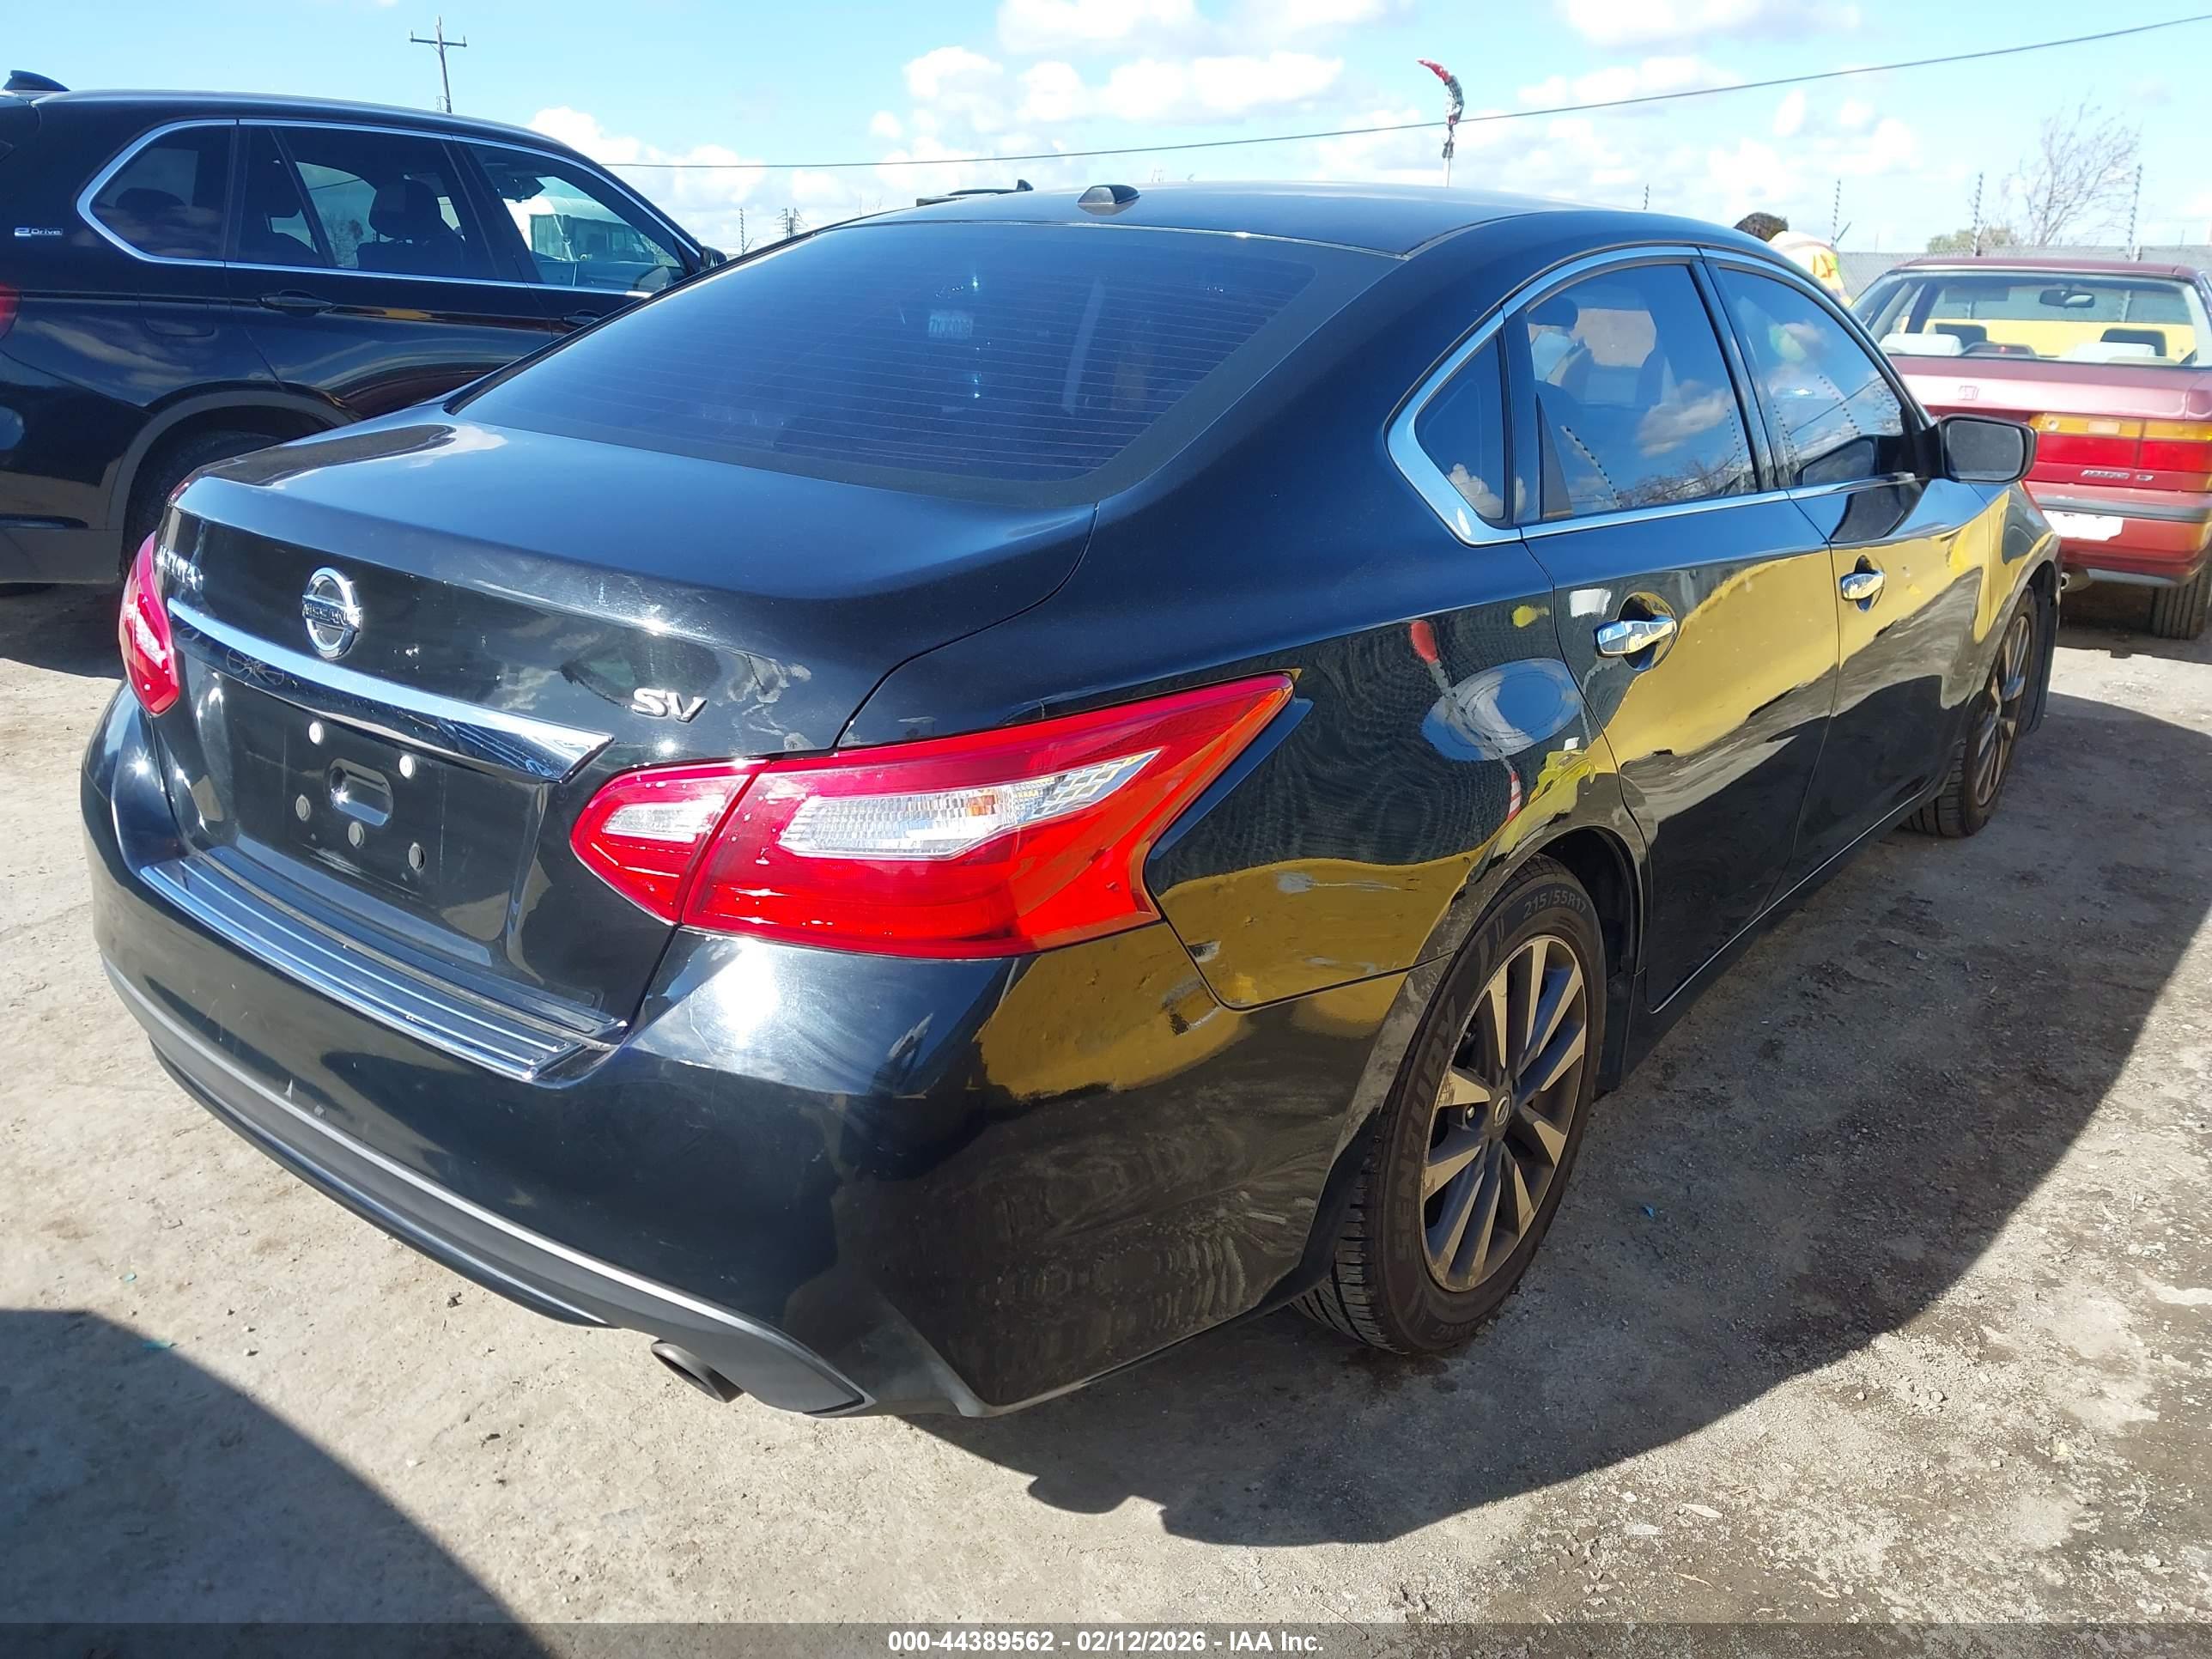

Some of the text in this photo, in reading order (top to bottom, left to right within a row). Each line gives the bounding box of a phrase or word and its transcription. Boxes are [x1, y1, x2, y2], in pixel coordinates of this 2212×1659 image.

[302, 602, 349, 627] NISSAN
[631, 688, 708, 723] SV
[1522, 889, 1587, 921] 215/55R17
